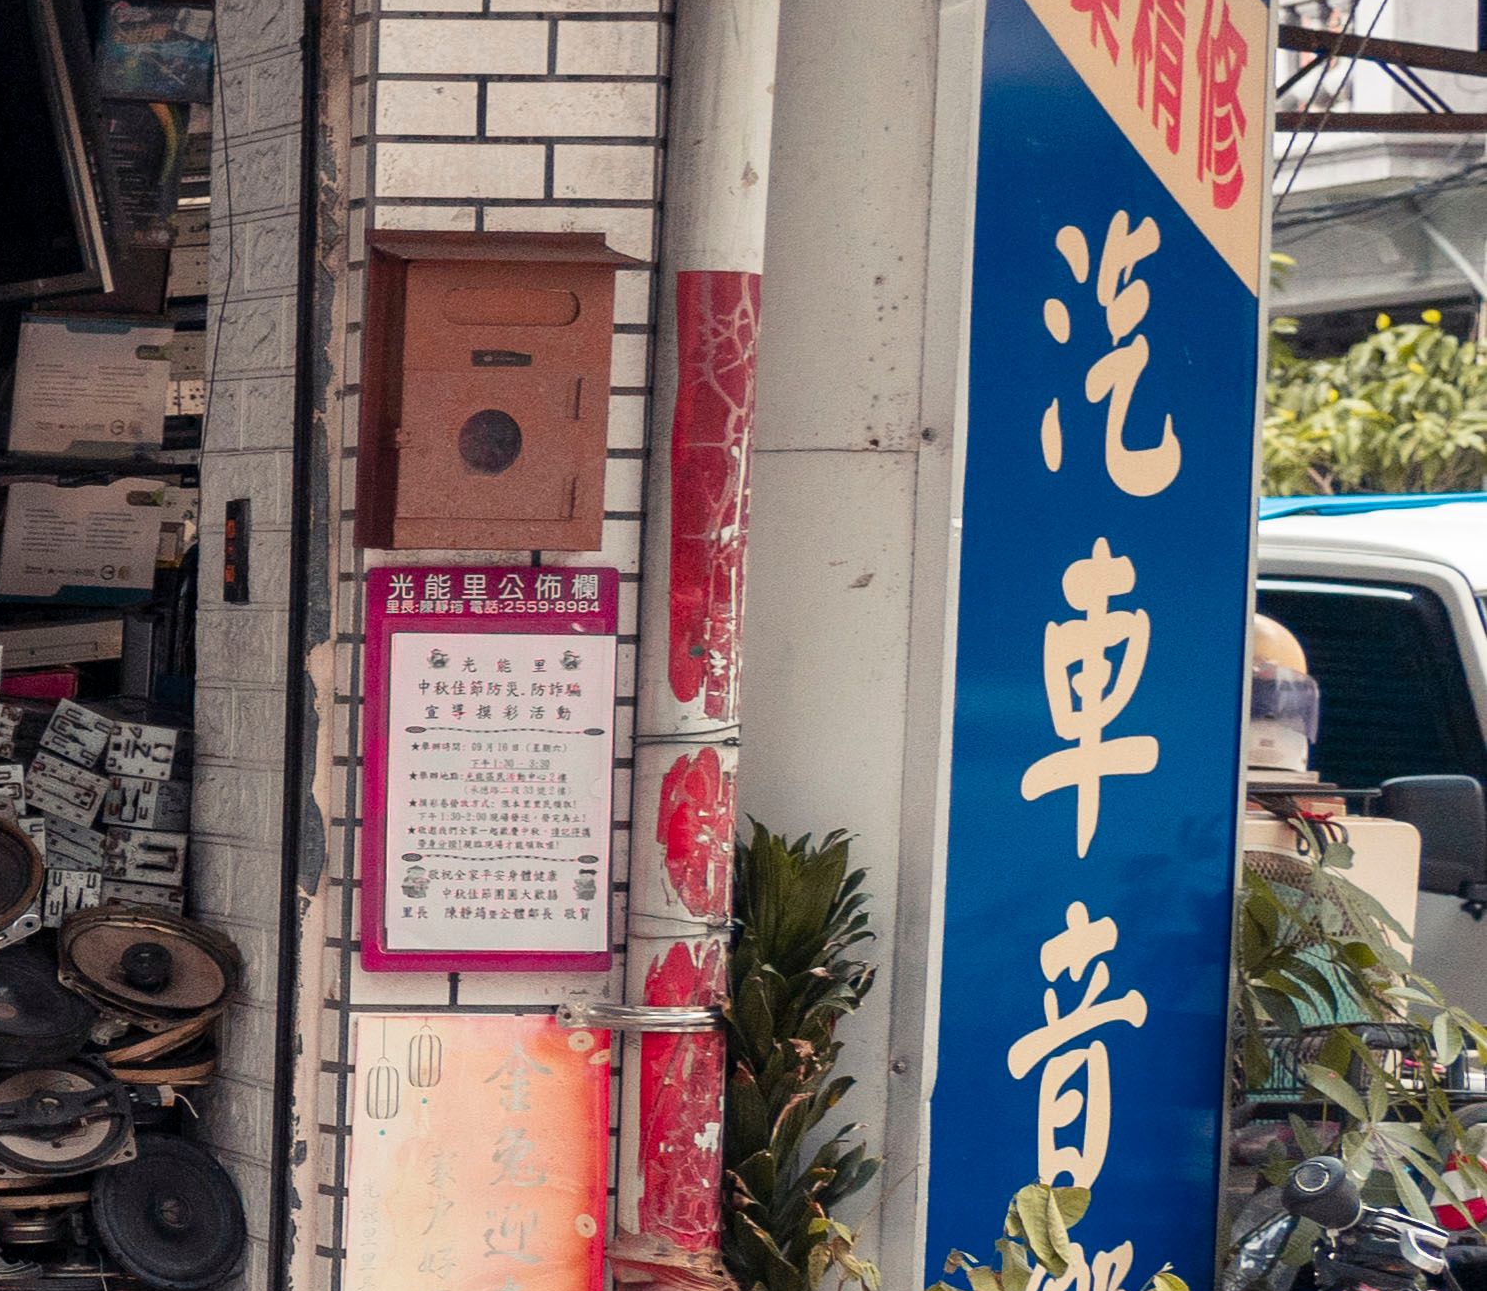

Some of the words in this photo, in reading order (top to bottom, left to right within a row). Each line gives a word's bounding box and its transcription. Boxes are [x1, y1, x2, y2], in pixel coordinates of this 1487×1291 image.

[387, 573, 599, 601] 光能里公佈欄
[461, 657, 548, 674] 光能里
